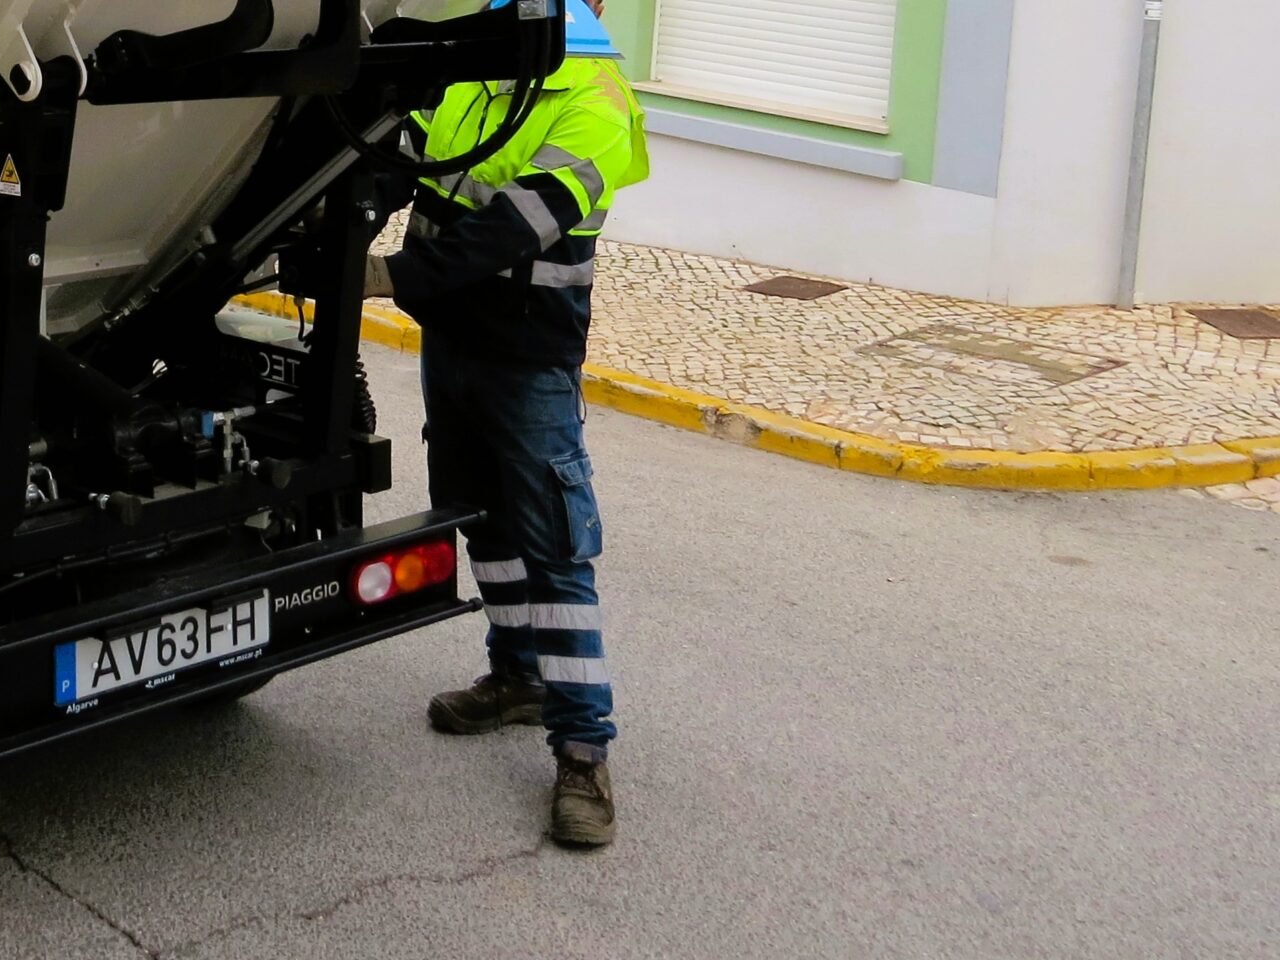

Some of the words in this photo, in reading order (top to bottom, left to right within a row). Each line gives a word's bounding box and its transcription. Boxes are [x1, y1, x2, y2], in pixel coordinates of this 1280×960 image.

[274, 581, 340, 612] PIAGGIO
[219, 648, 262, 667] www.mscar.pt
[61, 680, 70, 692] P
[153, 673, 176, 685] mscar
[66, 698, 99, 714] Algarve
